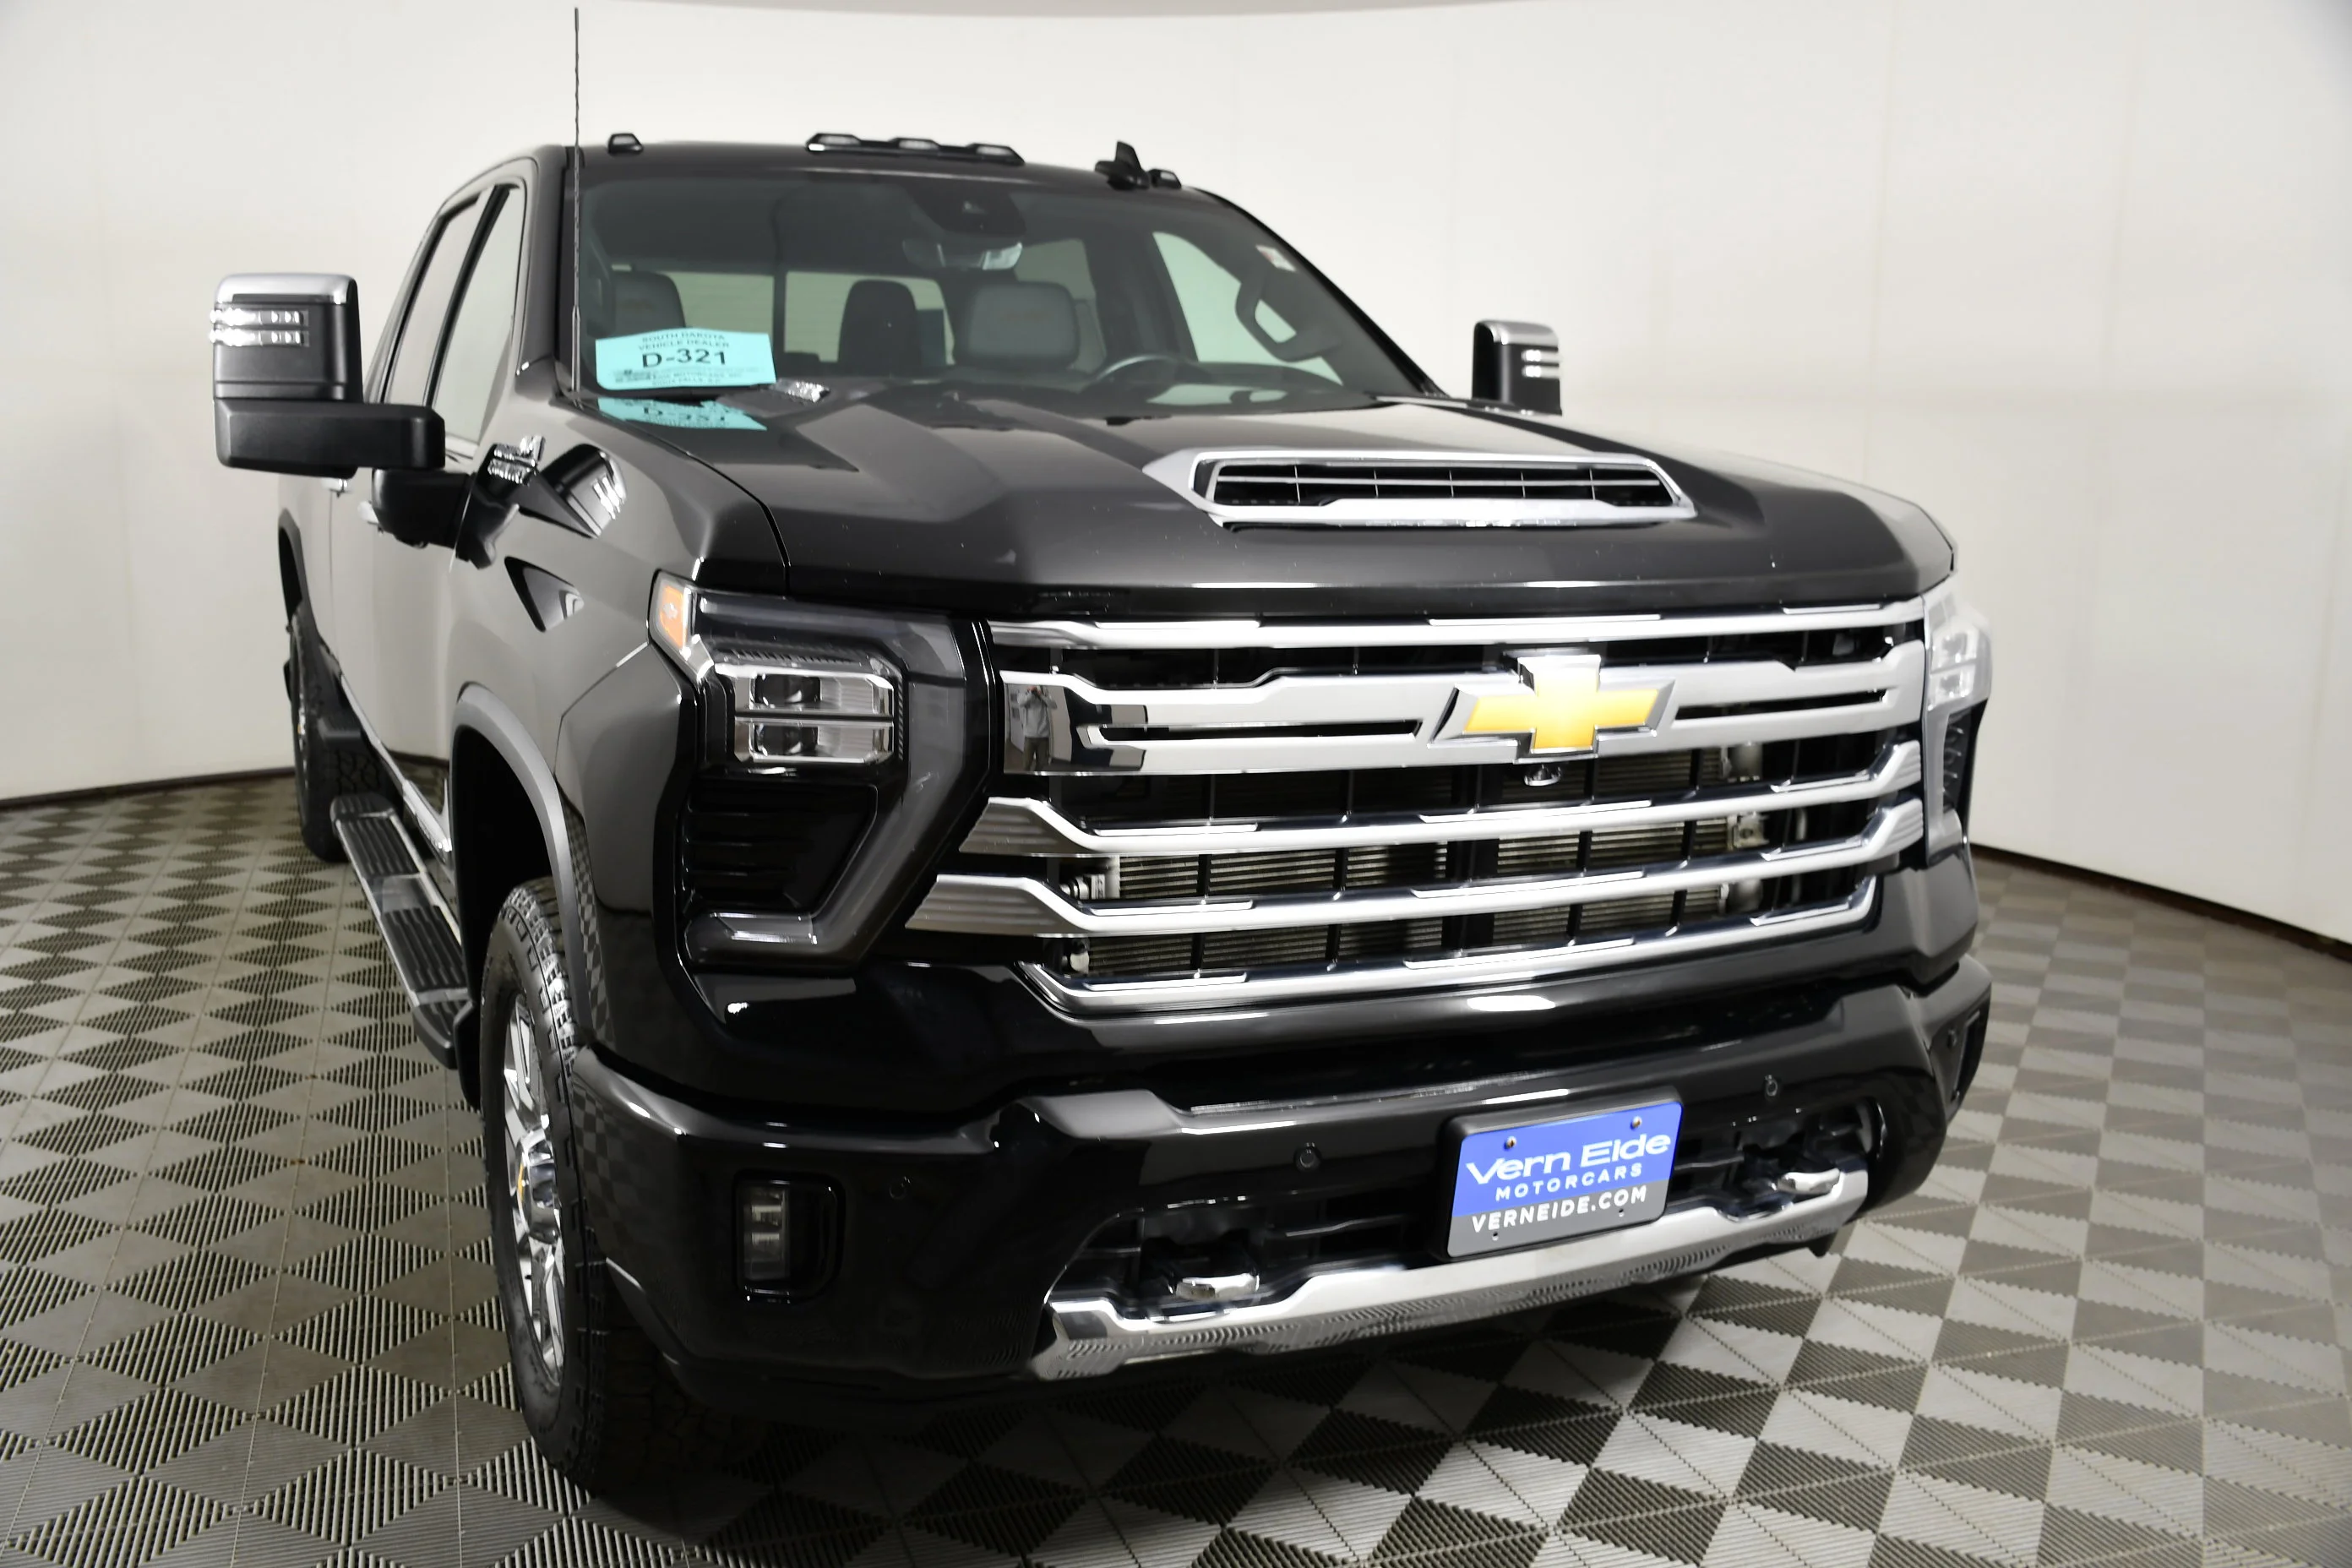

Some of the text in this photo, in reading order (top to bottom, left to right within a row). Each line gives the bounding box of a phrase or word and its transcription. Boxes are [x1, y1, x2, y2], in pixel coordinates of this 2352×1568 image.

[638, 338, 730, 351] VEHICLE DEALER
[642, 331, 726, 342] SOUTH DAKOTA
[641, 348, 727, 368] D-321
[1466, 1152, 1571, 1185] Vern
[1495, 1162, 1642, 1201] MOTORCARS
[1472, 1184, 1647, 1233] VERNEIDE.COM
